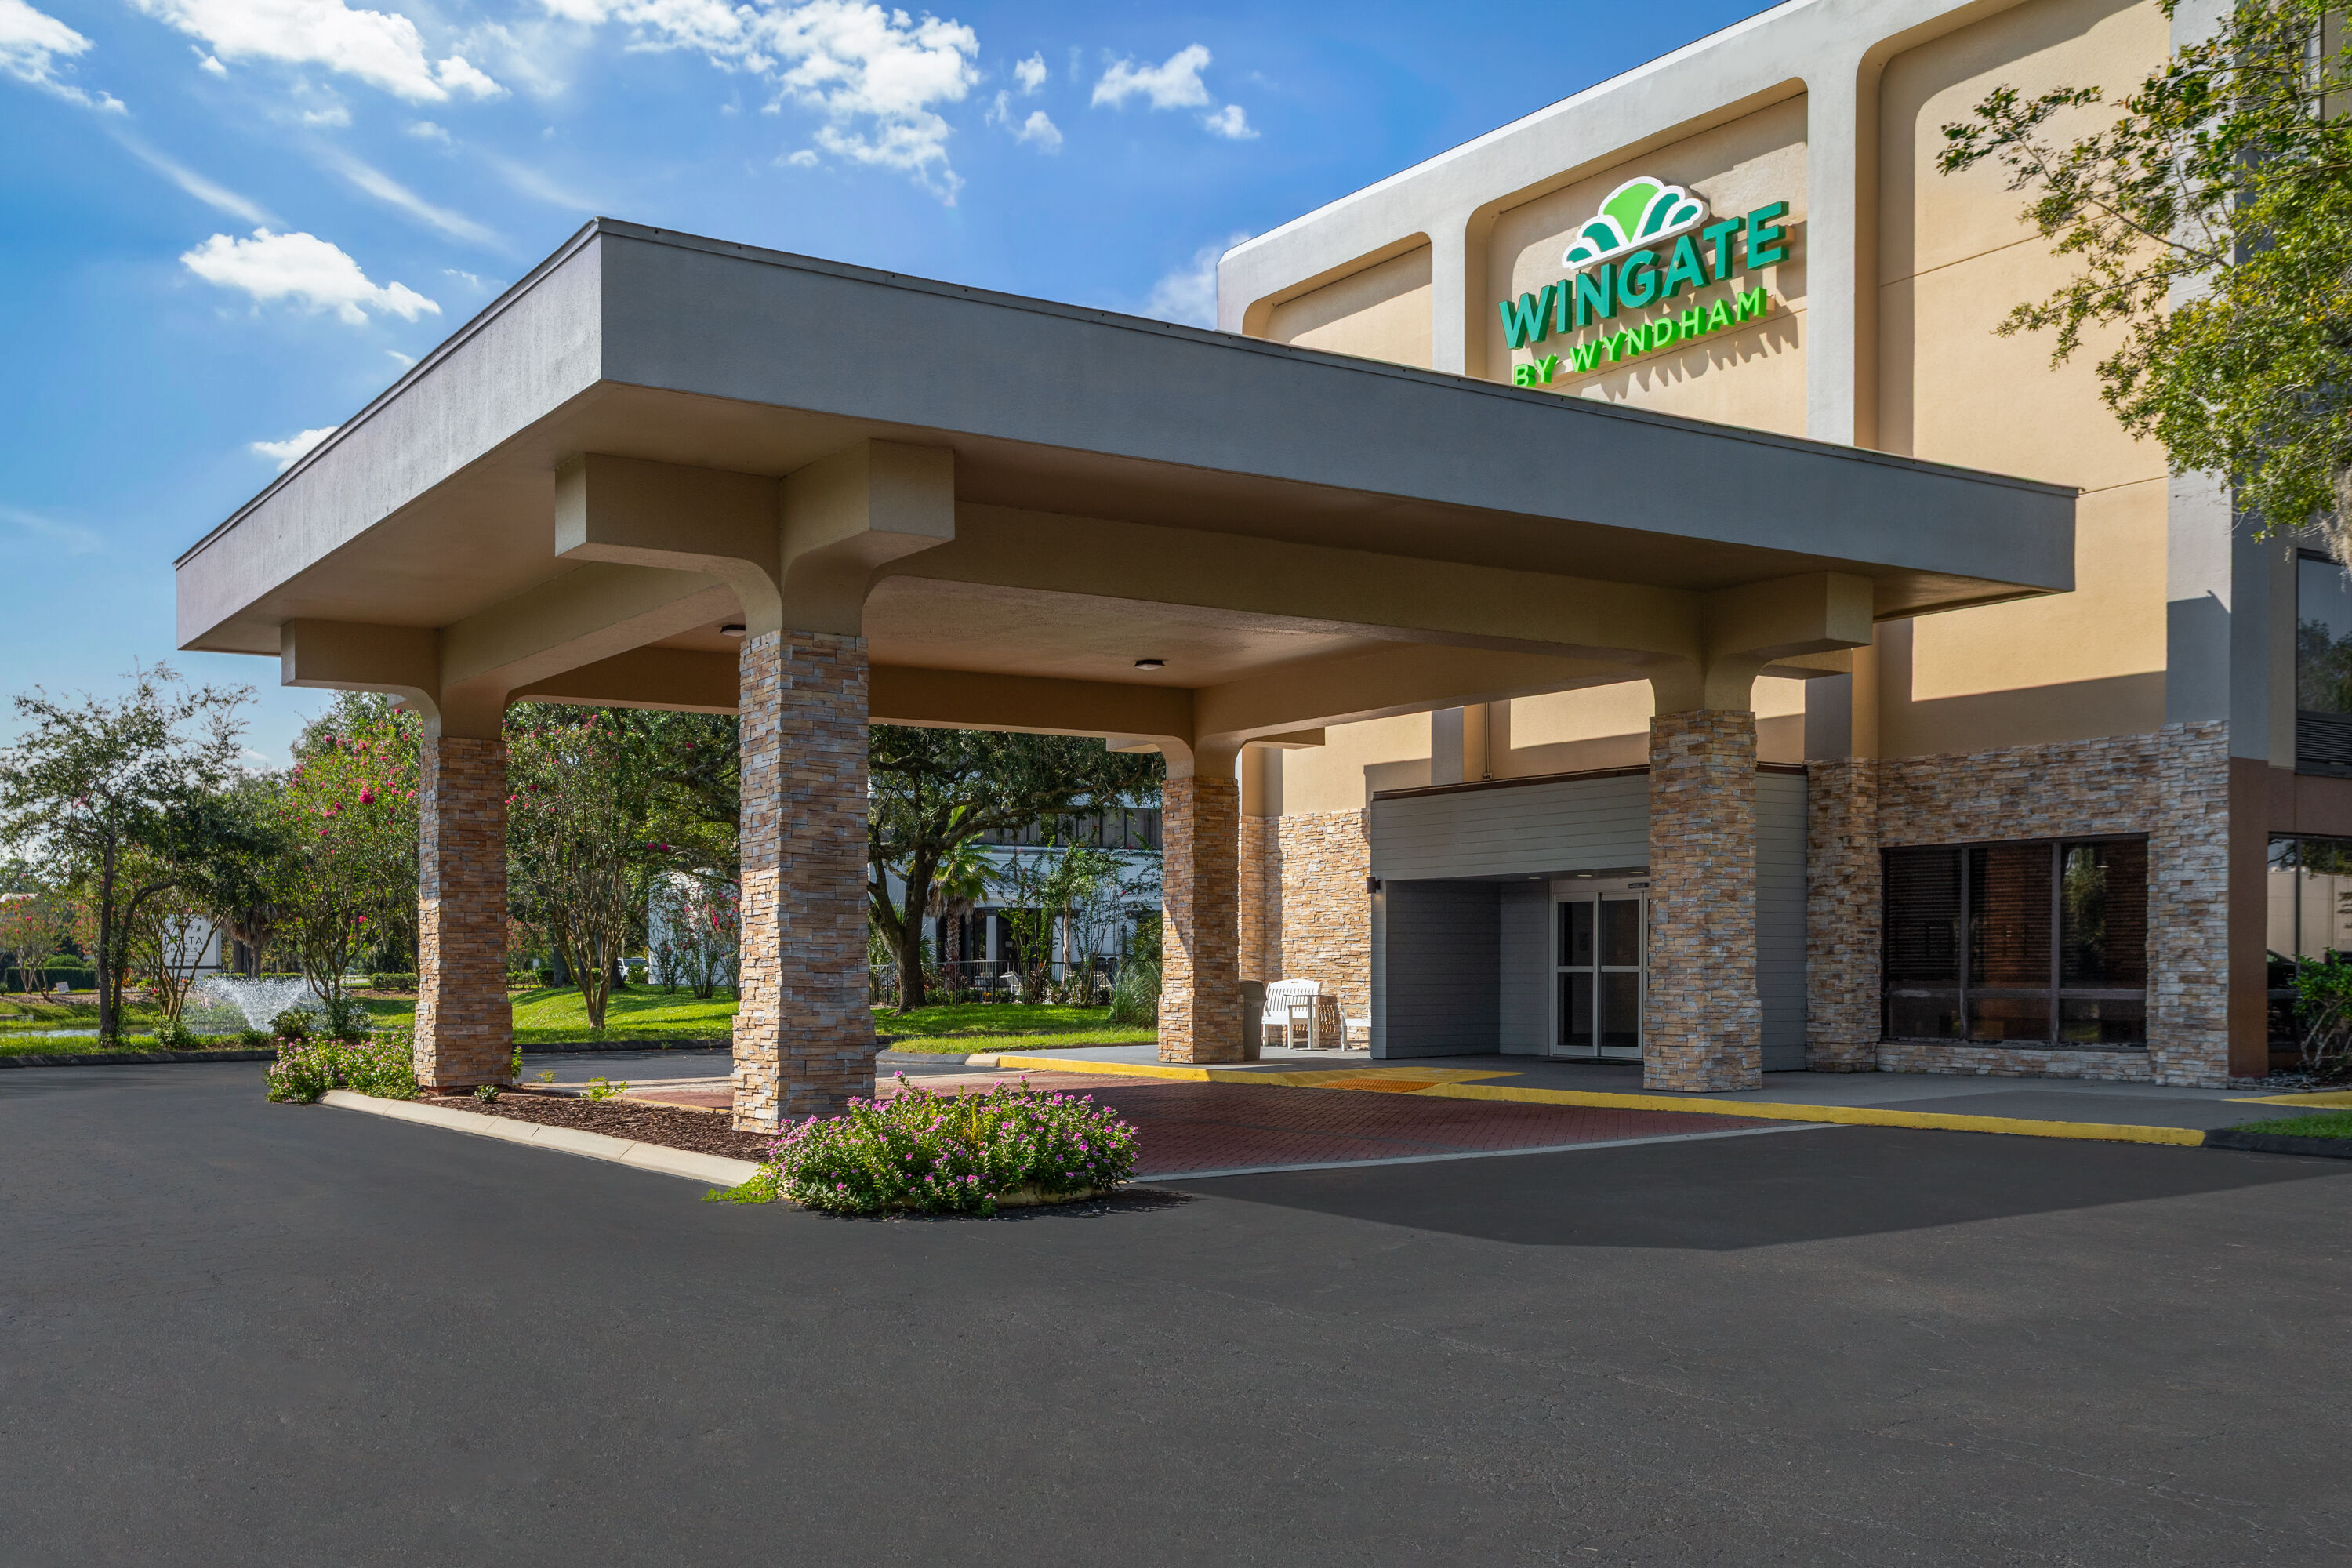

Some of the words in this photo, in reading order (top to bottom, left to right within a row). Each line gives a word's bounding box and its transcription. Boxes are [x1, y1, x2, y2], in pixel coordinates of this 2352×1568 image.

[1499, 201, 1789, 350] WINGATE
[1514, 354, 1558, 387] BY
[1570, 286, 1766, 373] WYNDHAM
